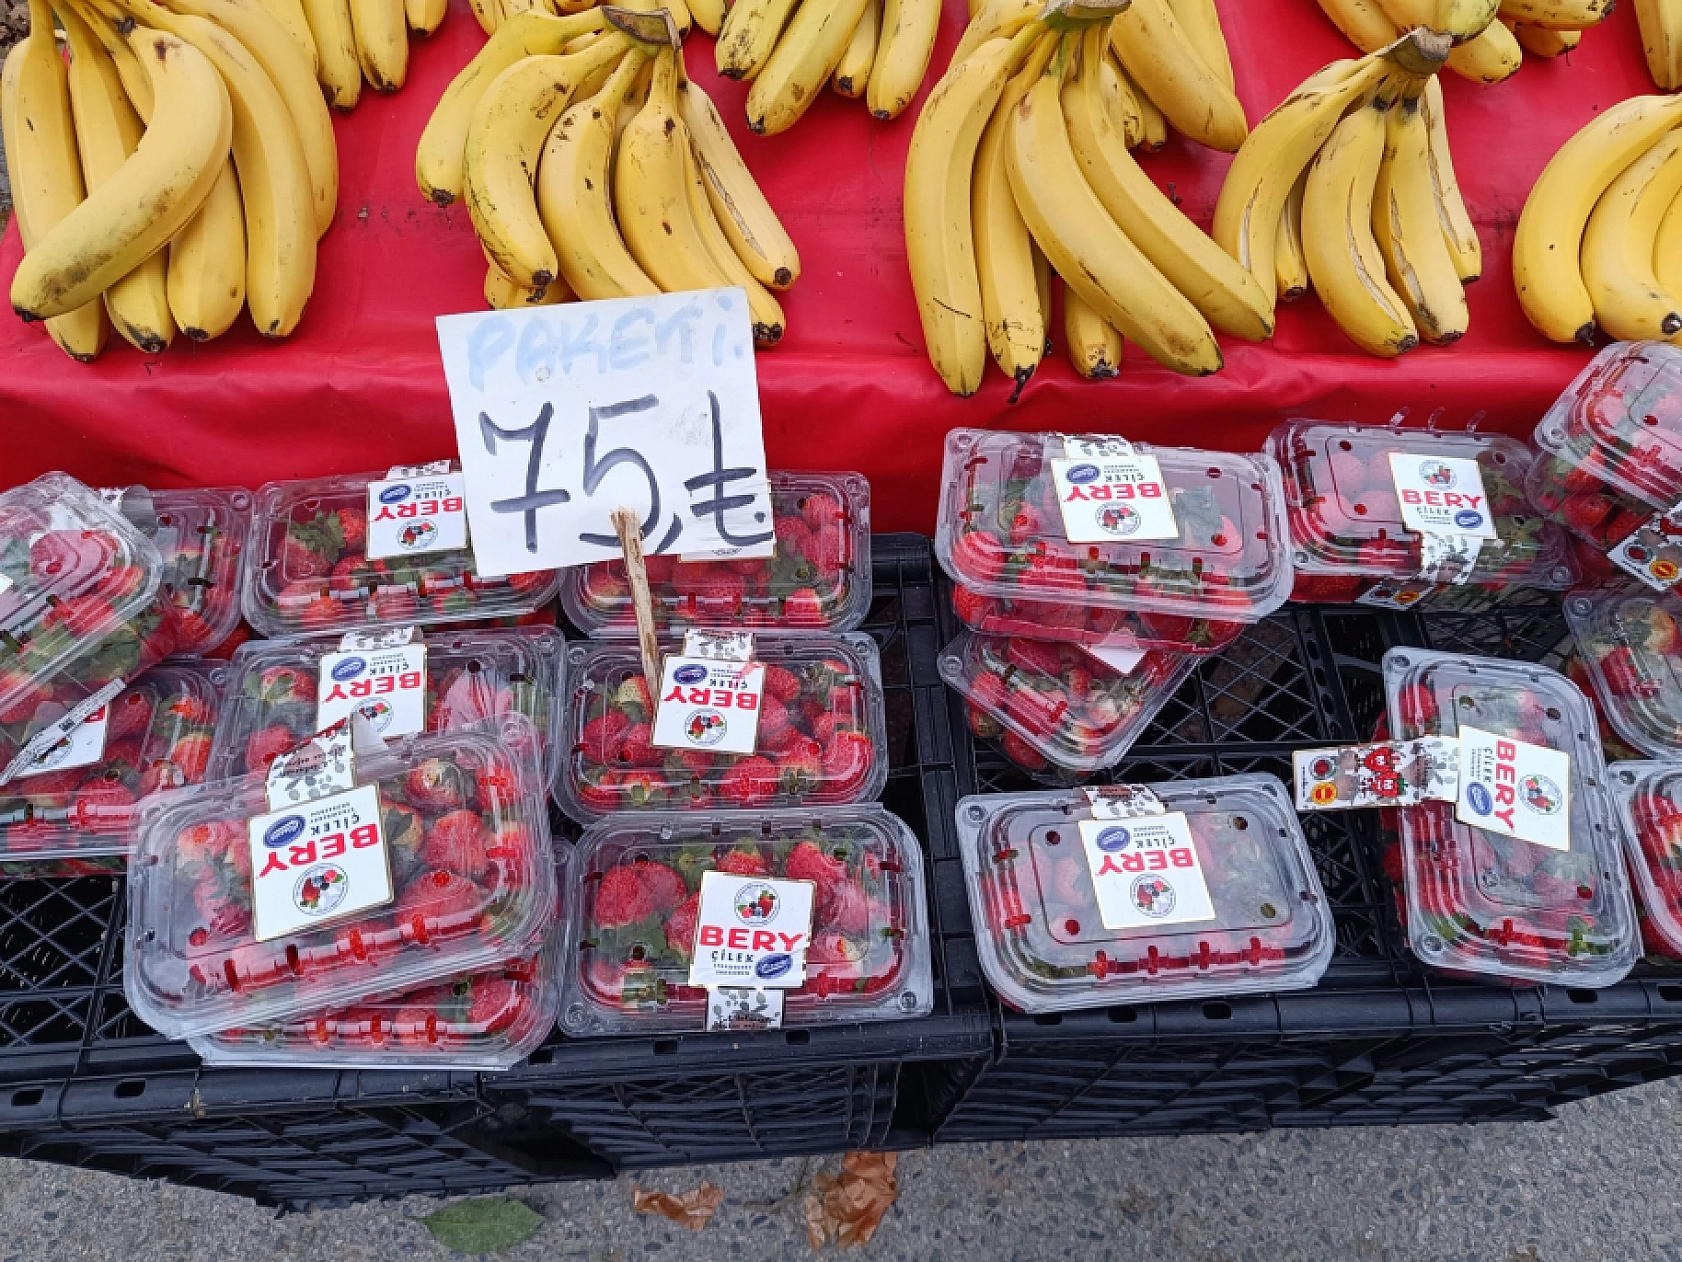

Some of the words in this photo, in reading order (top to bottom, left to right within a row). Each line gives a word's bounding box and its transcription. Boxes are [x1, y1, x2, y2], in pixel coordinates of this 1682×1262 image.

[1067, 482, 1162, 502] BERY
[1403, 489, 1481, 509] BERY
[375, 496, 463, 522] BERY
[326, 671, 421, 703] BERY
[665, 685, 760, 711] BERY
[1495, 740, 1516, 830] BERY
[260, 823, 379, 878] BERY
[1098, 847, 1194, 876] BERY
[698, 925, 803, 952] BERY
